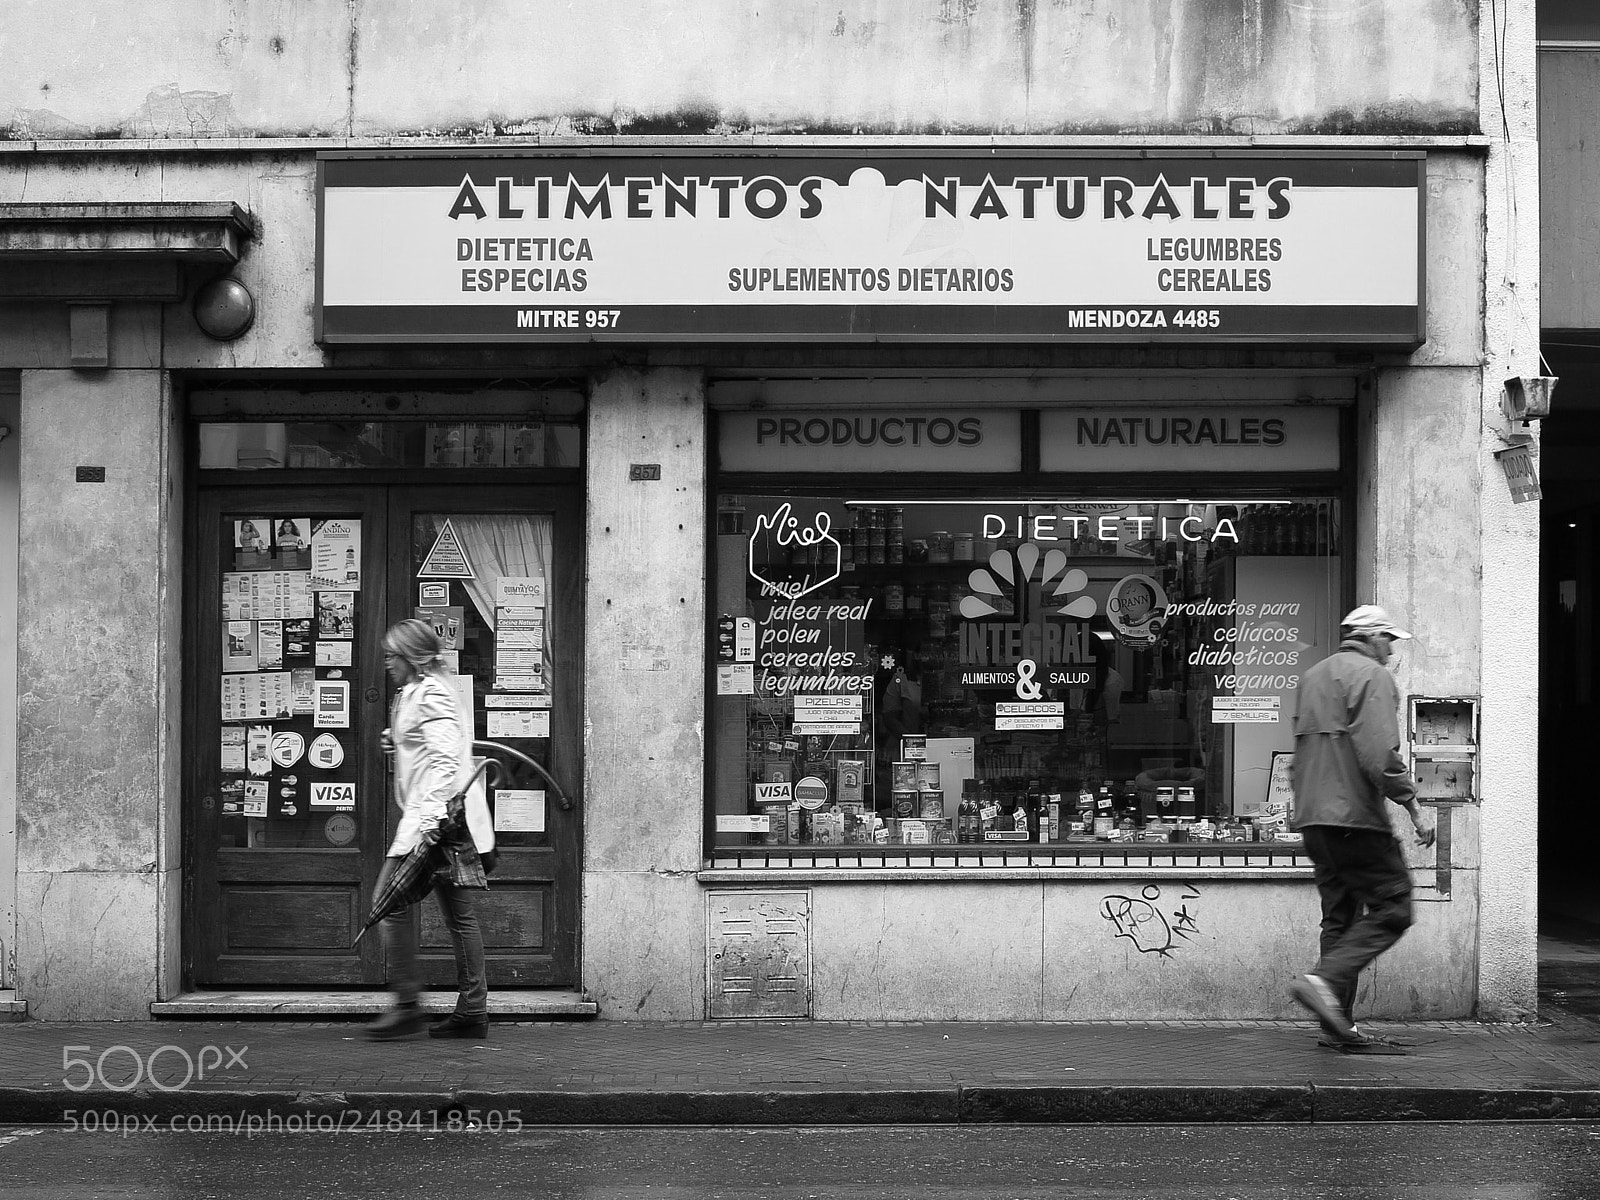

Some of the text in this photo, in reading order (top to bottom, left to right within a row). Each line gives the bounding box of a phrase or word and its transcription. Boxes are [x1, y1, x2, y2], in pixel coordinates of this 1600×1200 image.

[447, 172, 1294, 222] ALIMENTOS NATURALES
[456, 238, 593, 262] DIETETICA
[1147, 238, 1283, 262] LEGUMBRES
[461, 267, 588, 292] ESPECIAS
[728, 267, 1014, 292] SUPLEMENTOS DIETARIOS
[1157, 267, 1272, 292] CEREALES
[516, 310, 621, 329] MITRE 957
[1068, 310, 1221, 328] MENDOZA 4485
[756, 417, 983, 447] PRODUCTOS
[1076, 417, 1287, 447] NATURALES
[633, 466, 658, 479] 957
[756, 502, 833, 546] Miel
[983, 514, 1239, 543] DIETETICA
[760, 573, 810, 597] miel
[759, 598, 873, 625] jalea real
[1163, 597, 1257, 619] productos
[1258, 602, 1300, 618] para
[760, 623, 821, 649] polen
[1213, 621, 1299, 642] celíacos
[760, 645, 856, 667] cereales
[959, 622, 1097, 667] INTEGRAL
[1188, 643, 1299, 666] diabeticos
[759, 668, 875, 696] legumbres
[961, 659, 1090, 700] ALIMENTOS & SALUD
[1213, 673, 1300, 695] veganos
[805, 698, 851, 706] PIZELAS
[315, 786, 353, 801] VISA
[757, 785, 791, 798] VISA
